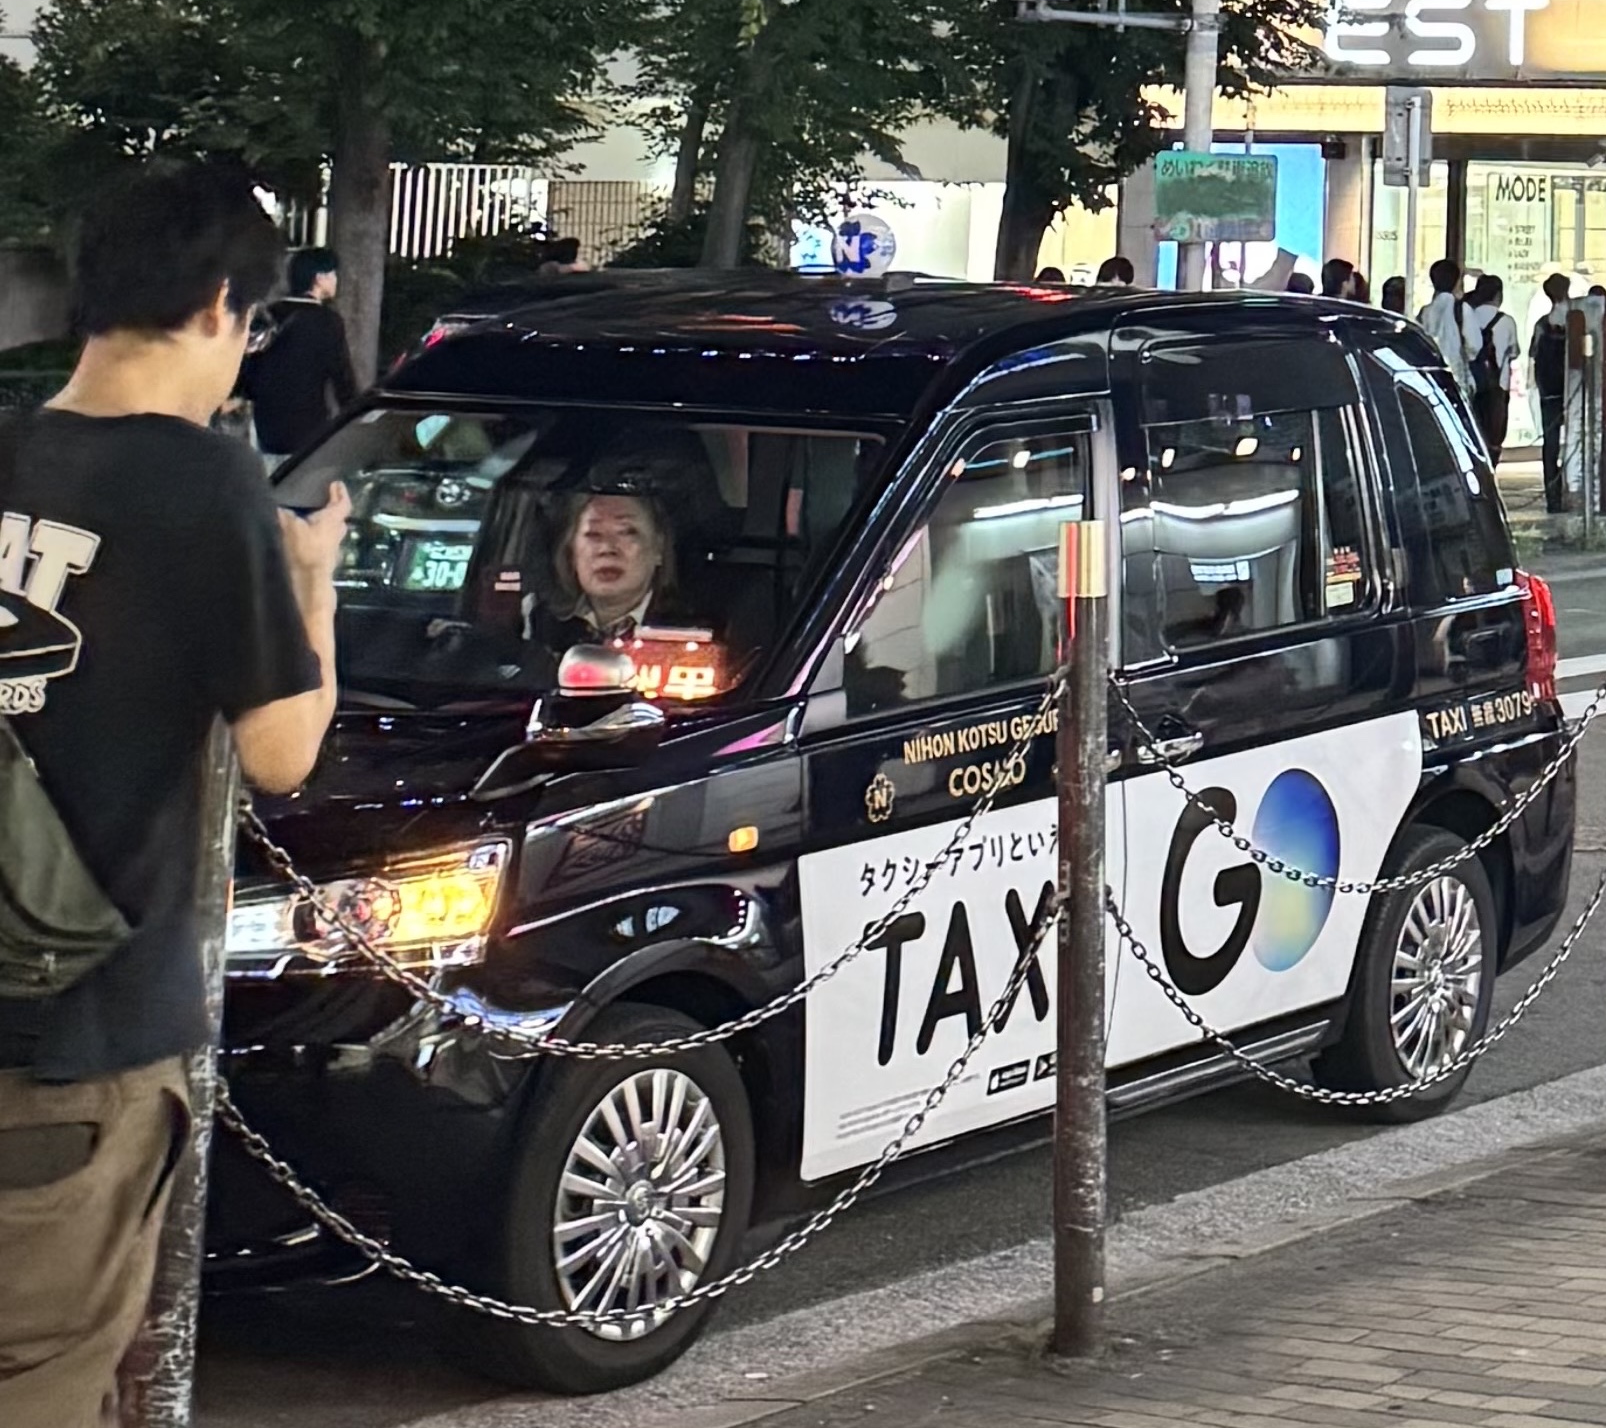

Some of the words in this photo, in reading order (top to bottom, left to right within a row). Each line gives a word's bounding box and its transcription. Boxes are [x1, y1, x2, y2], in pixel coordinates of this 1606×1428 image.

[1496, 174, 1546, 203] MODE
[1426, 705, 1468, 740] TAXI
[903, 731, 955, 766] NIHON
[958, 720, 1008, 753] KOTSU
[864, 880, 1058, 1066] TAX
